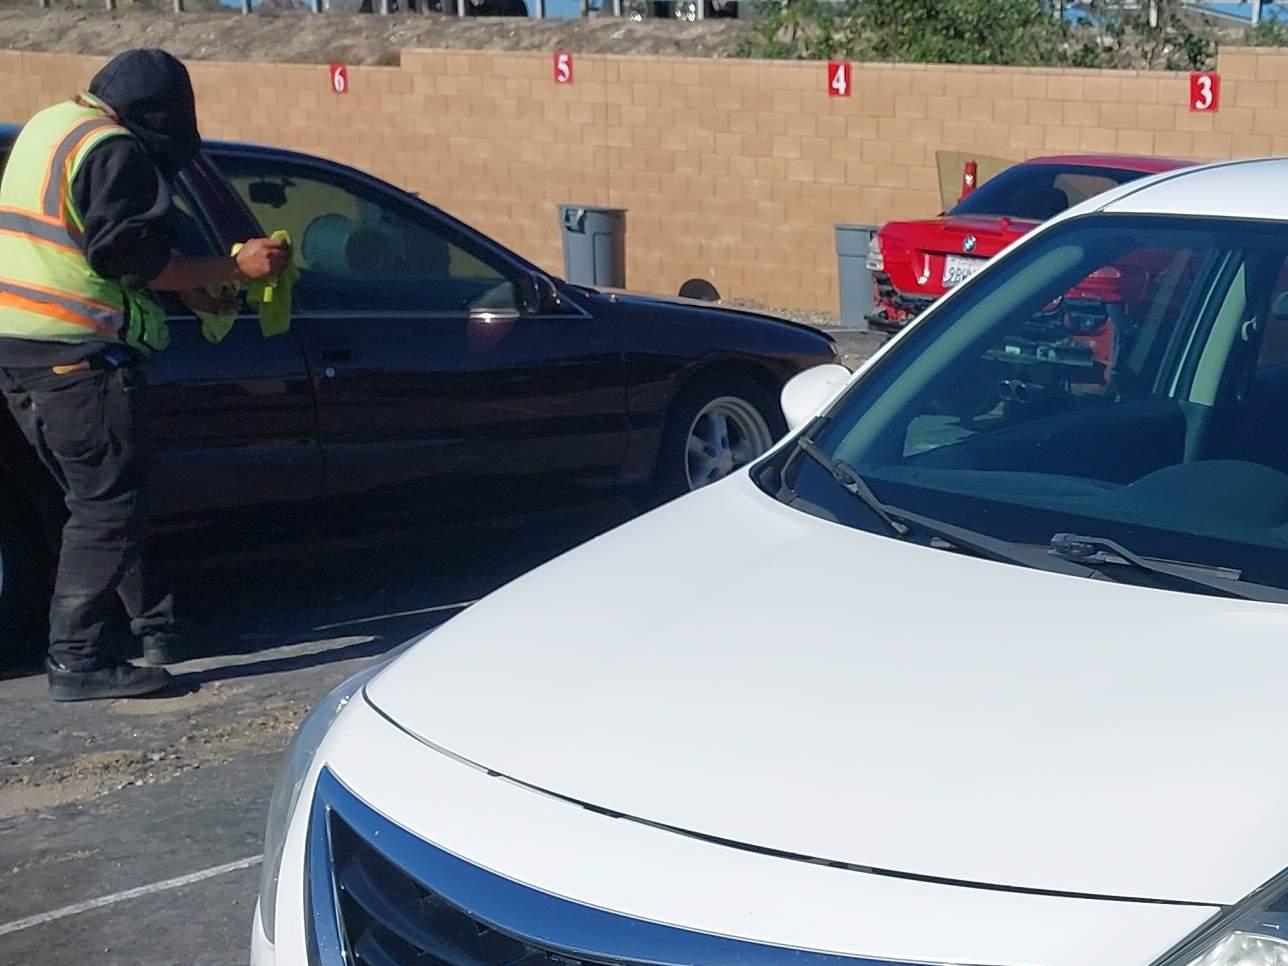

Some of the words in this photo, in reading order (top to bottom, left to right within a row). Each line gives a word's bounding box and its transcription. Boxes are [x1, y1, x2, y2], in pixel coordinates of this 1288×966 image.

[334, 67, 346, 92] 6
[557, 53, 570, 83] 5
[832, 65, 848, 95] 4
[1195, 75, 1214, 109] 3
